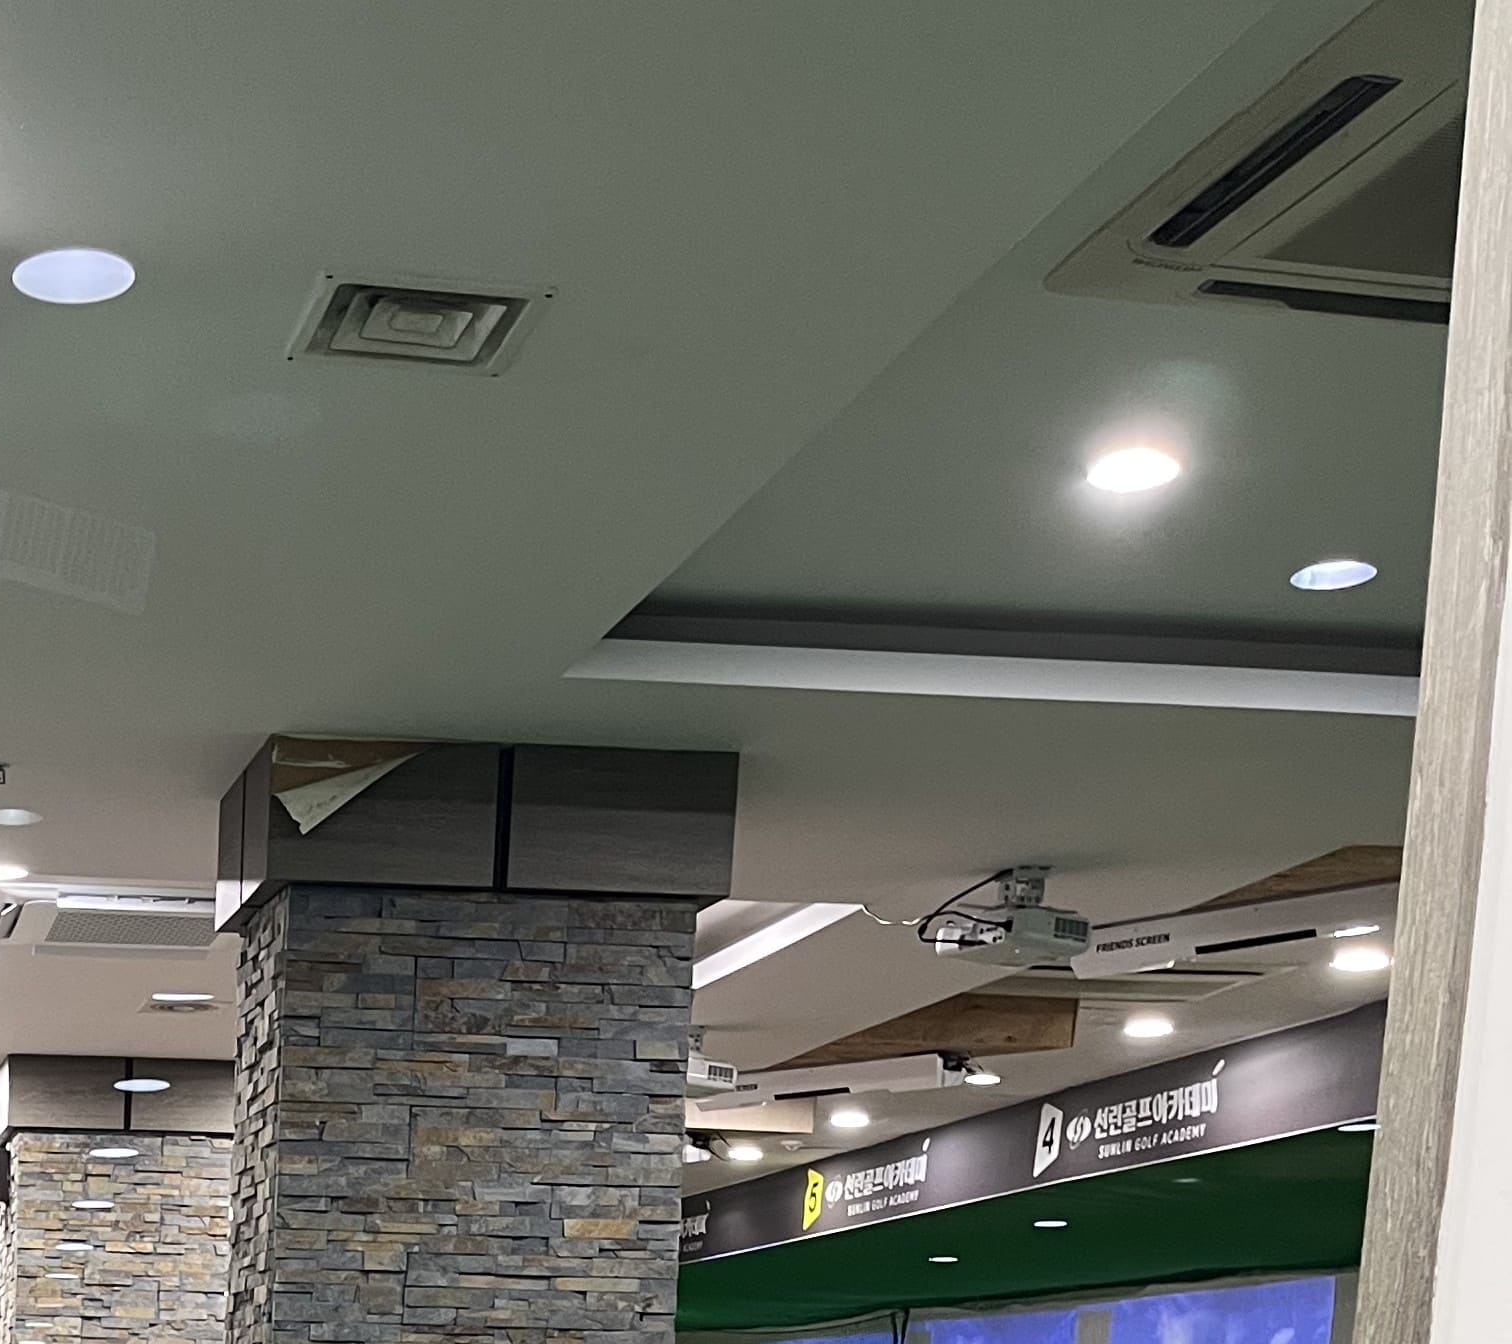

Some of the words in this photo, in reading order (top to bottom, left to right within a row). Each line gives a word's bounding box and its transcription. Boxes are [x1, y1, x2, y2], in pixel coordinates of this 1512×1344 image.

[1042, 1117, 1056, 1154] 4
[1094, 1077, 1218, 1139] 선린골프아카데미
[1098, 1140, 1133, 1160] SUNLIN
[1134, 1133, 1159, 1151] GOLF
[1160, 1123, 1207, 1145] ACADEMY
[808, 1182, 818, 1213] 5
[844, 1153, 928, 1201] 선린골프아카데미
